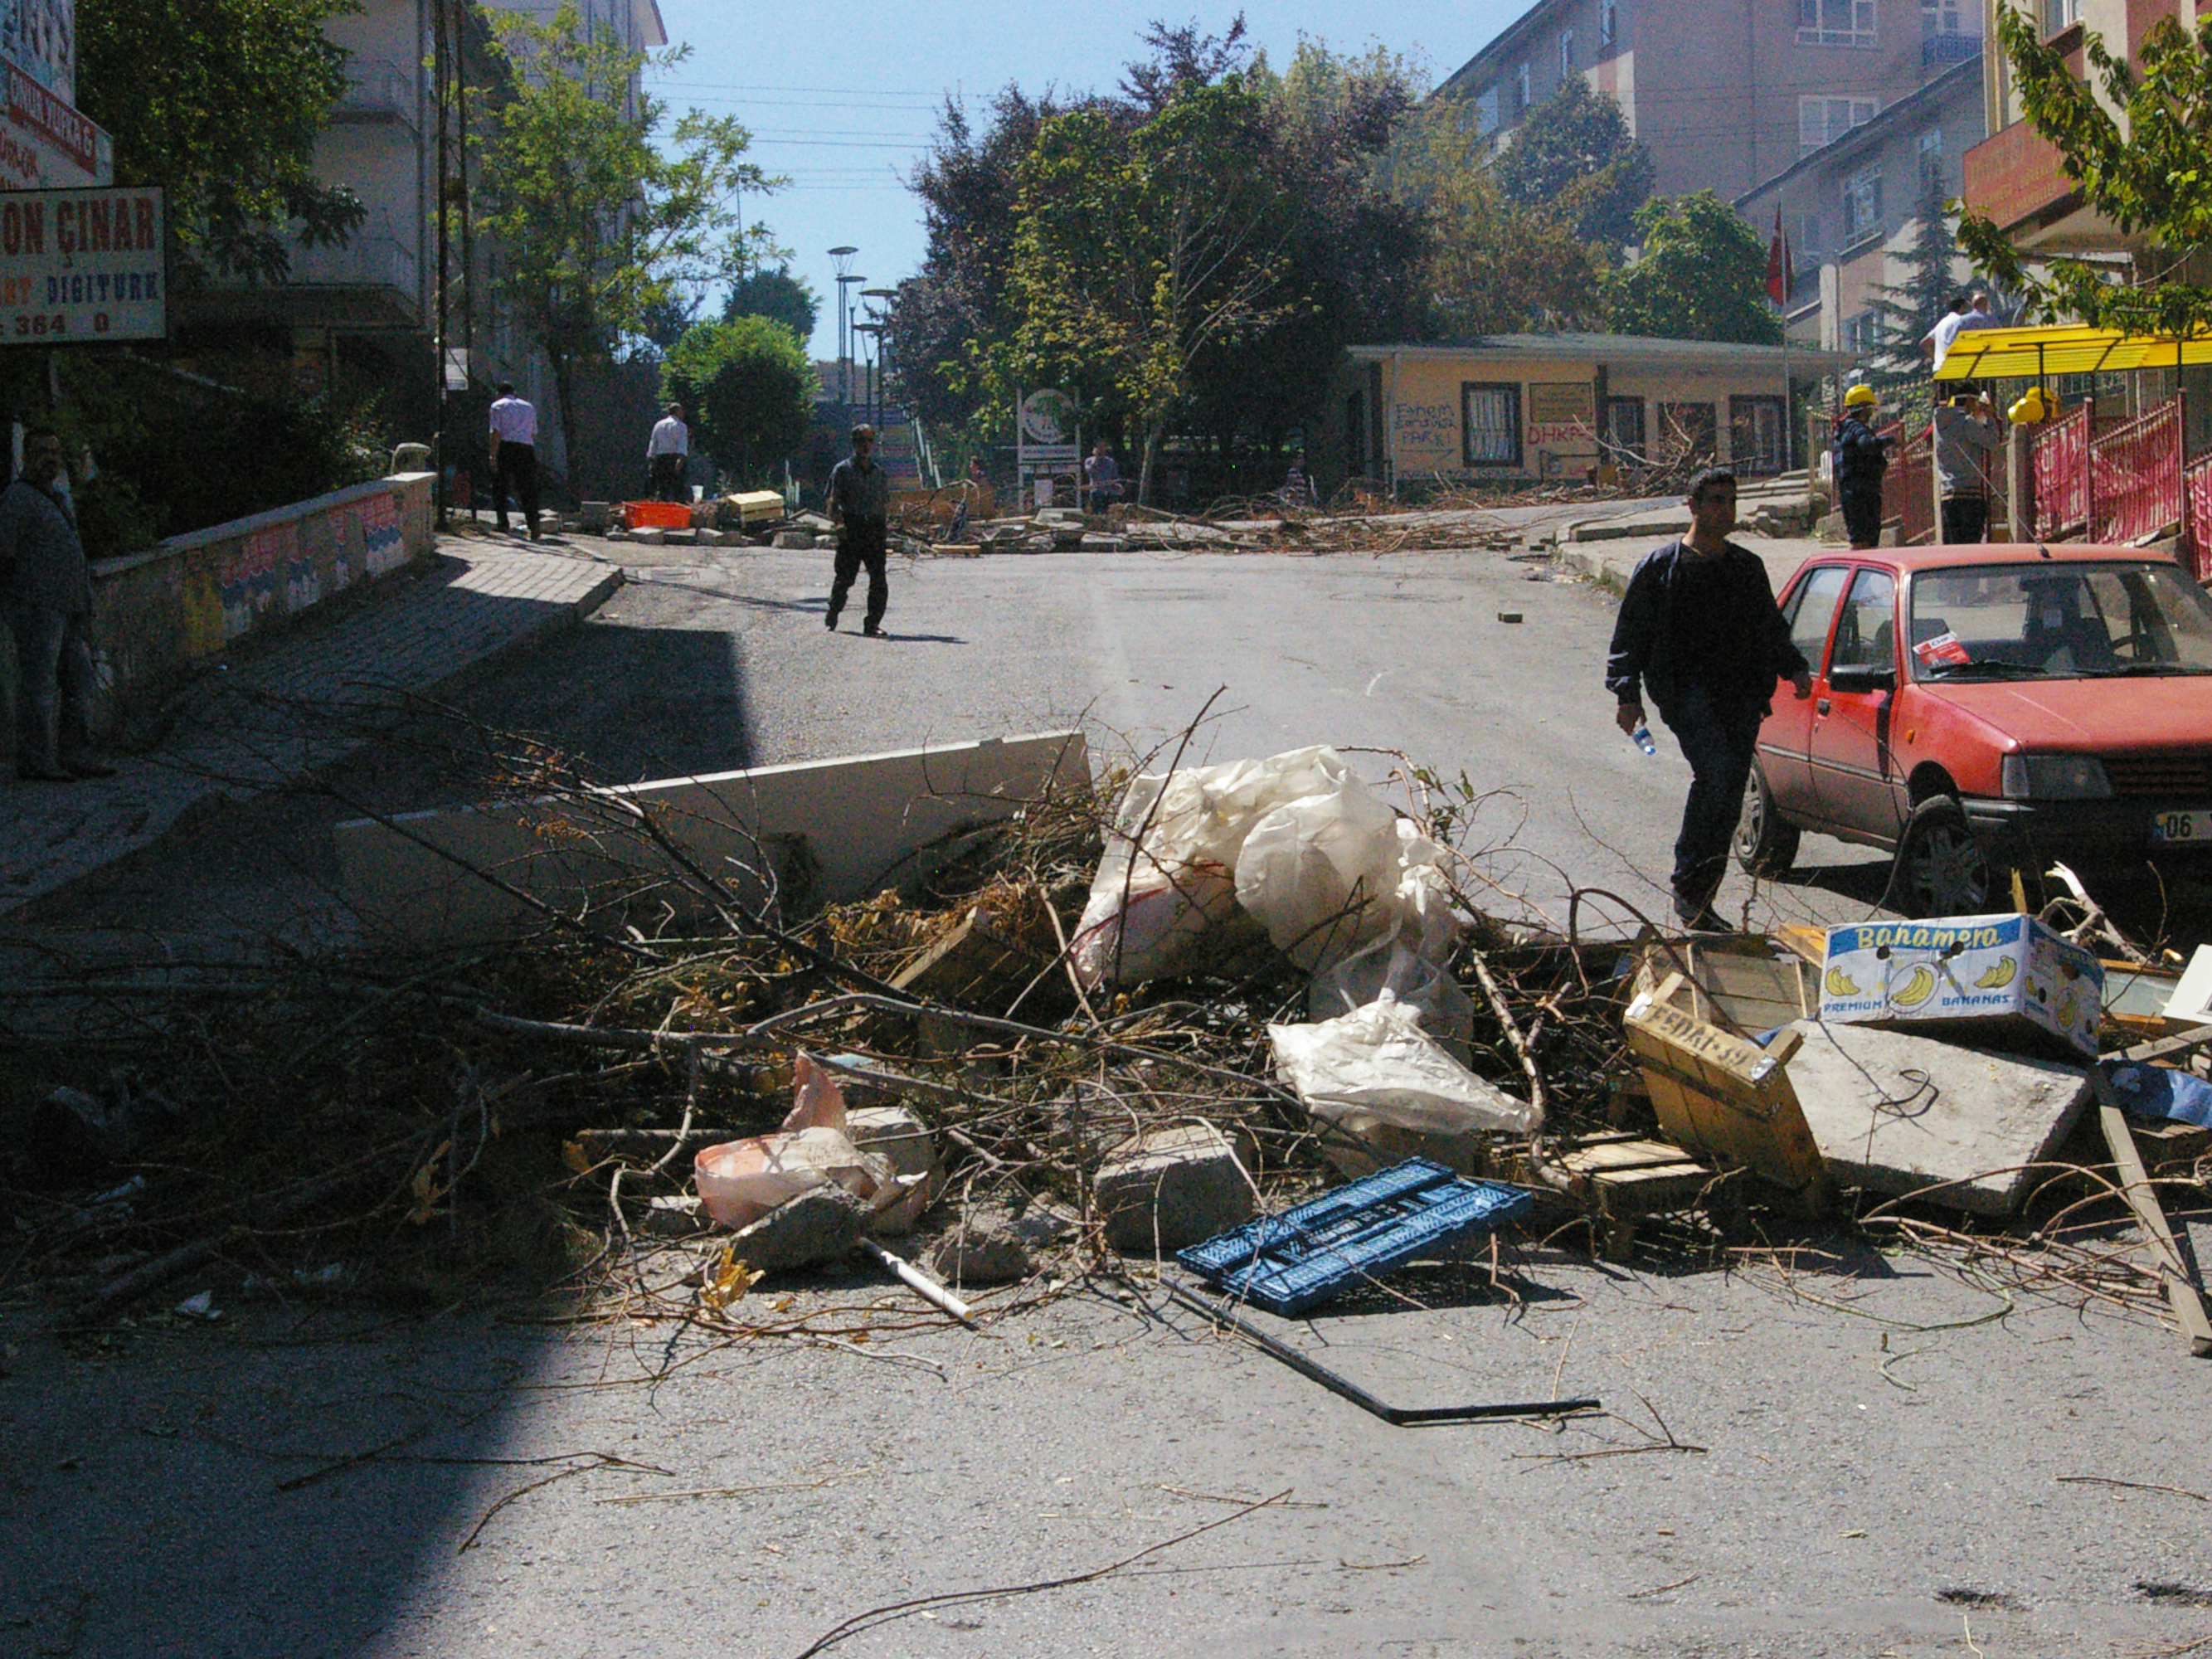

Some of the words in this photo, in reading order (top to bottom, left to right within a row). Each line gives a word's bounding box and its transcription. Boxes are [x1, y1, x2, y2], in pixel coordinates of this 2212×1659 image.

[57, 197, 156, 268] ÇINAR
[47, 271, 159, 304] DIGITURK
[2166, 814, 2192, 839] 06
[1823, 999, 1883, 1013] PREMIUM
[1942, 994, 2010, 1007] BANANAS
